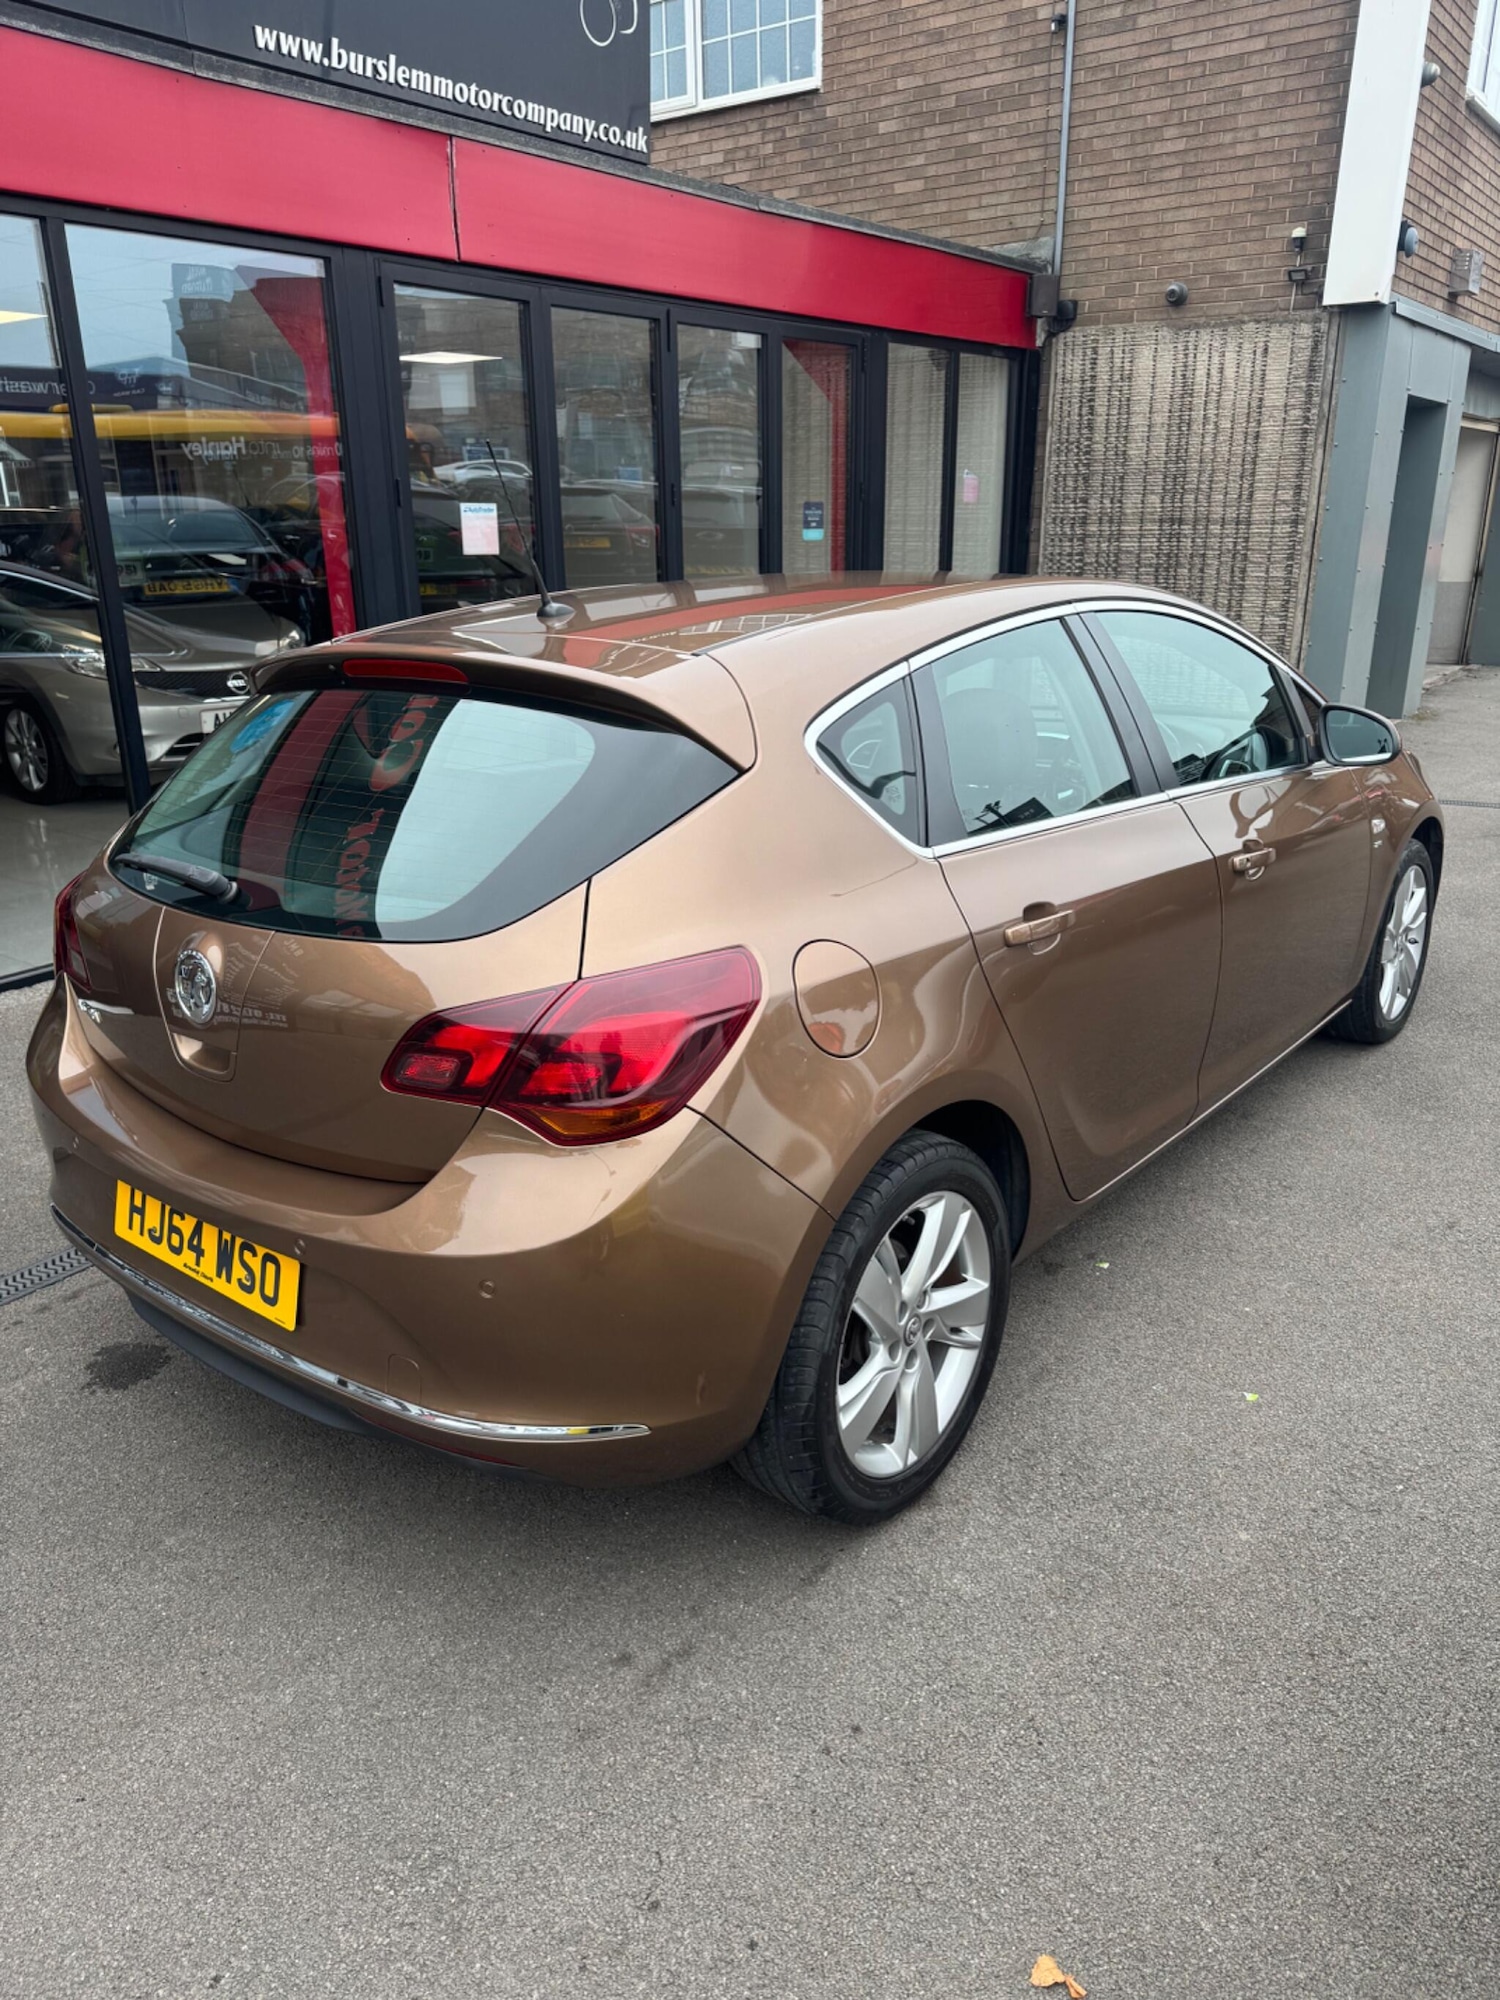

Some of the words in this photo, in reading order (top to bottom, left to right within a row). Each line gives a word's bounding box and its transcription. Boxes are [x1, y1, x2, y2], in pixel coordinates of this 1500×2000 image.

[253, 24, 648, 153] www.burslemmotorcompany.co.uk
[128, 1186, 205, 1267] HJ64
[215, 1228, 281, 1307] WSO
